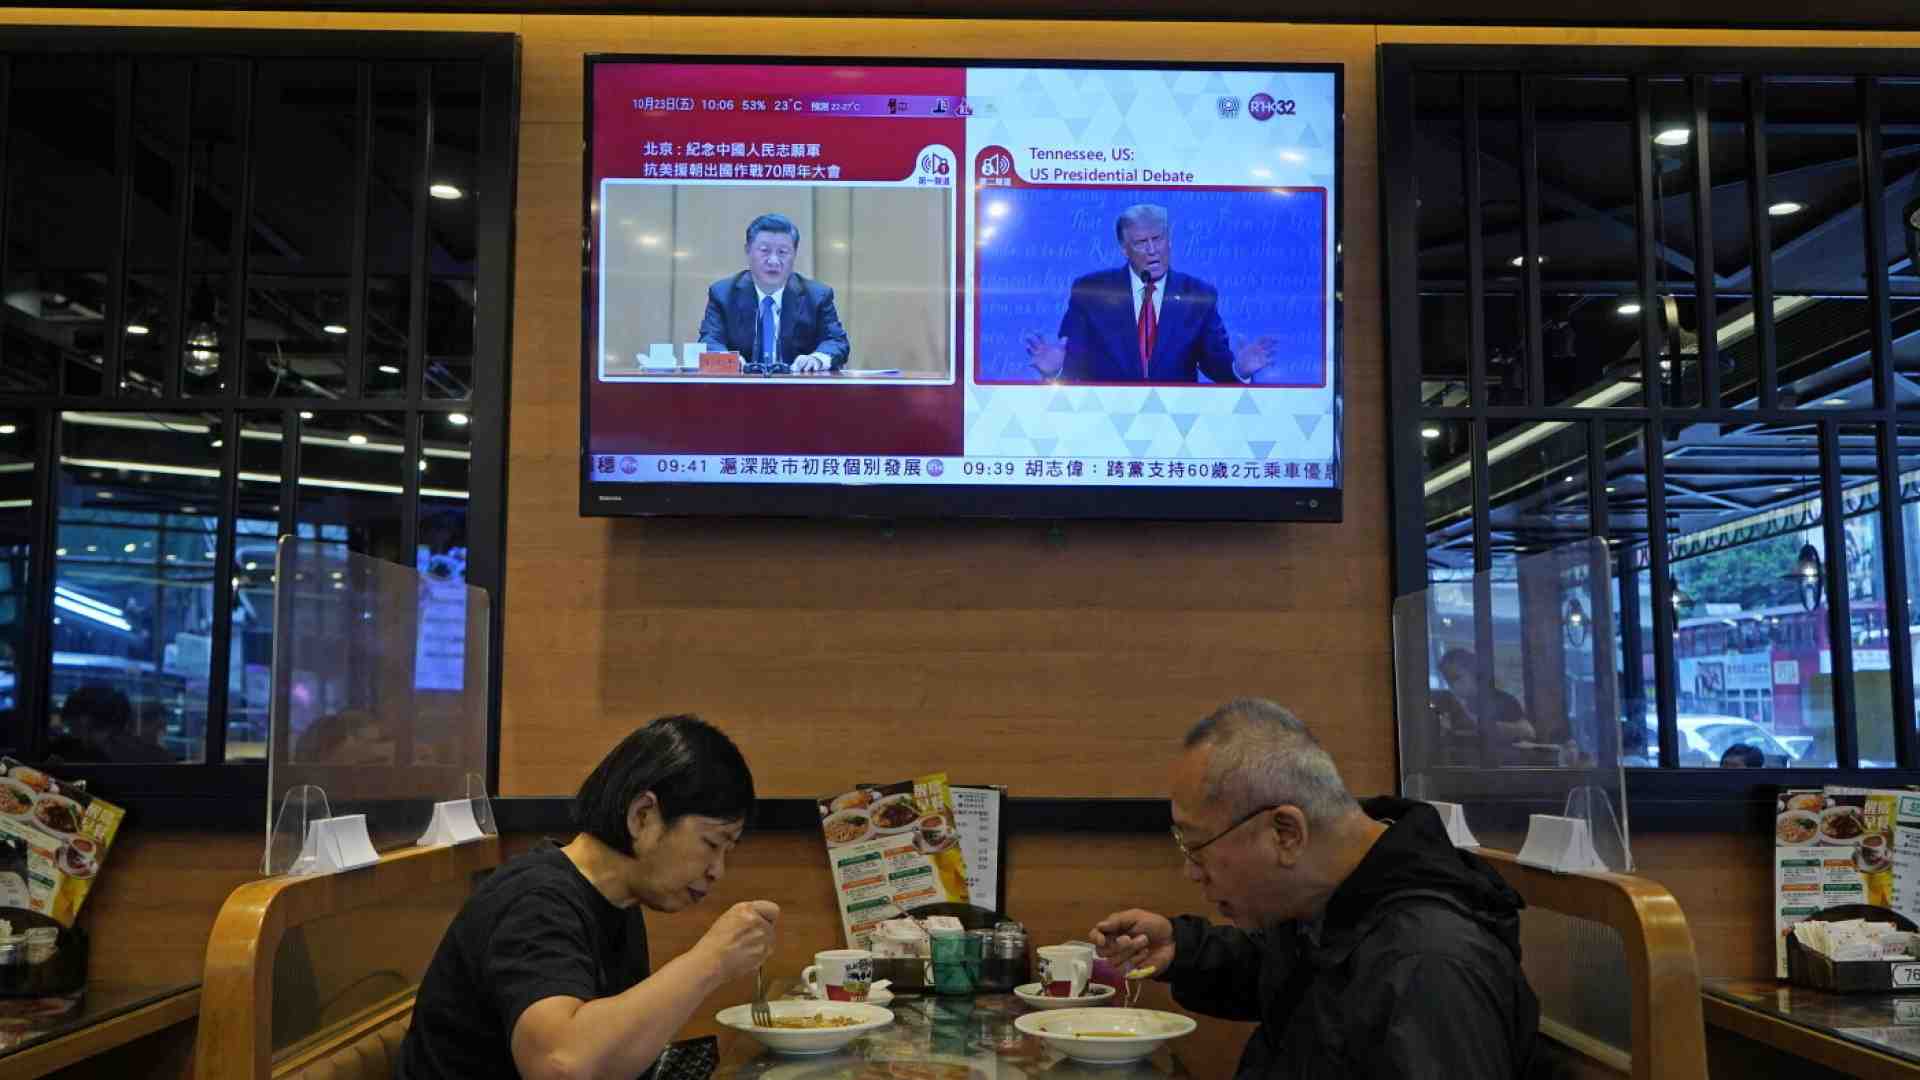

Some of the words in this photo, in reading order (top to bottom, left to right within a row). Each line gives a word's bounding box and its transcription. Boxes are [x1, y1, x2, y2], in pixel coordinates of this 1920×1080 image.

[702, 100, 734, 111] 10:06
[742, 100, 766, 111] 53%
[1029, 147, 1107, 162] Tennessee,
[1111, 148, 1135, 161] US:
[1030, 168, 1050, 182] US
[1054, 167, 1139, 183] Presidential
[1143, 169, 1194, 183] Debate
[657, 459, 707, 473] 09:41
[720, 457, 921, 476] 滬深股市初段個別發展
[963, 461, 1015, 476] 09:39
